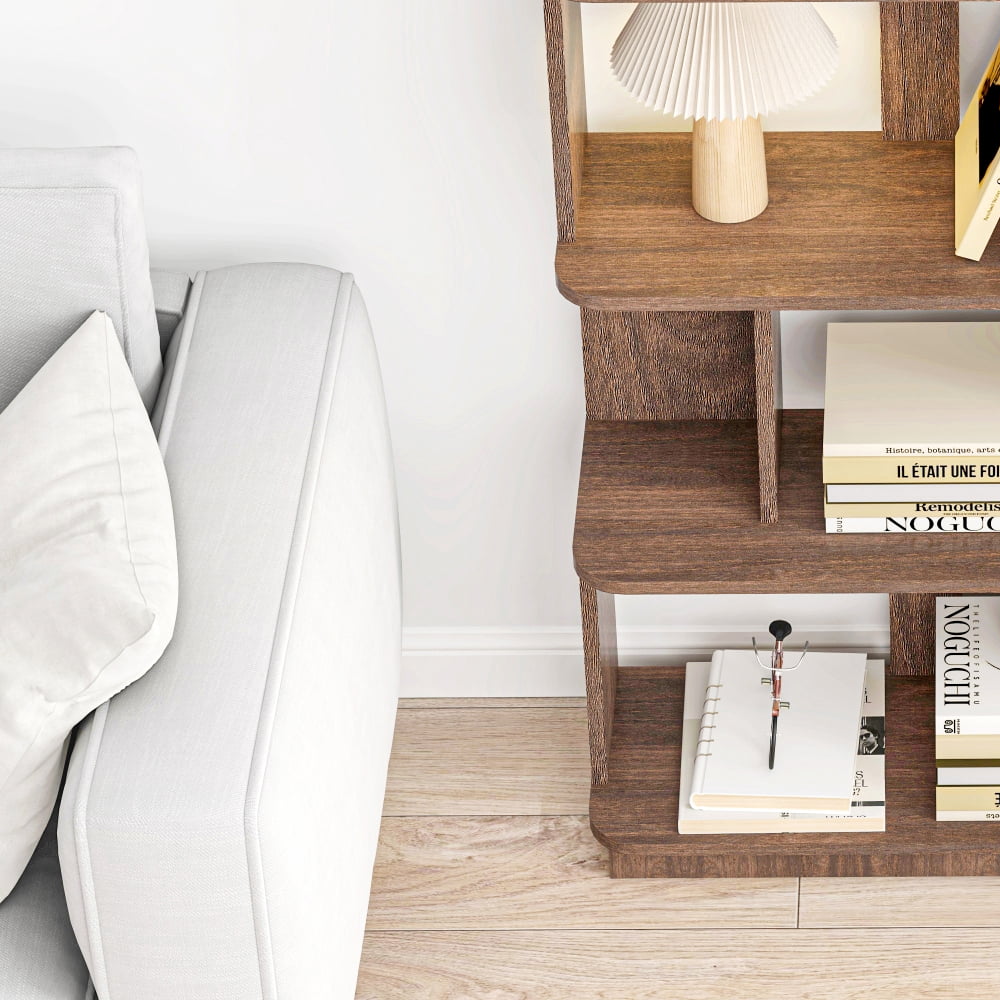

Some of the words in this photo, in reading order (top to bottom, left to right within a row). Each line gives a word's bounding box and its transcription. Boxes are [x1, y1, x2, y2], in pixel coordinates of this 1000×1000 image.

[927, 447, 974, 455] botanique,
[897, 464, 909, 478] IL
[911, 462, 948, 478] ÉTAIT
[951, 464, 977, 478] UNE
[943, 604, 971, 706] NOGUCHI
